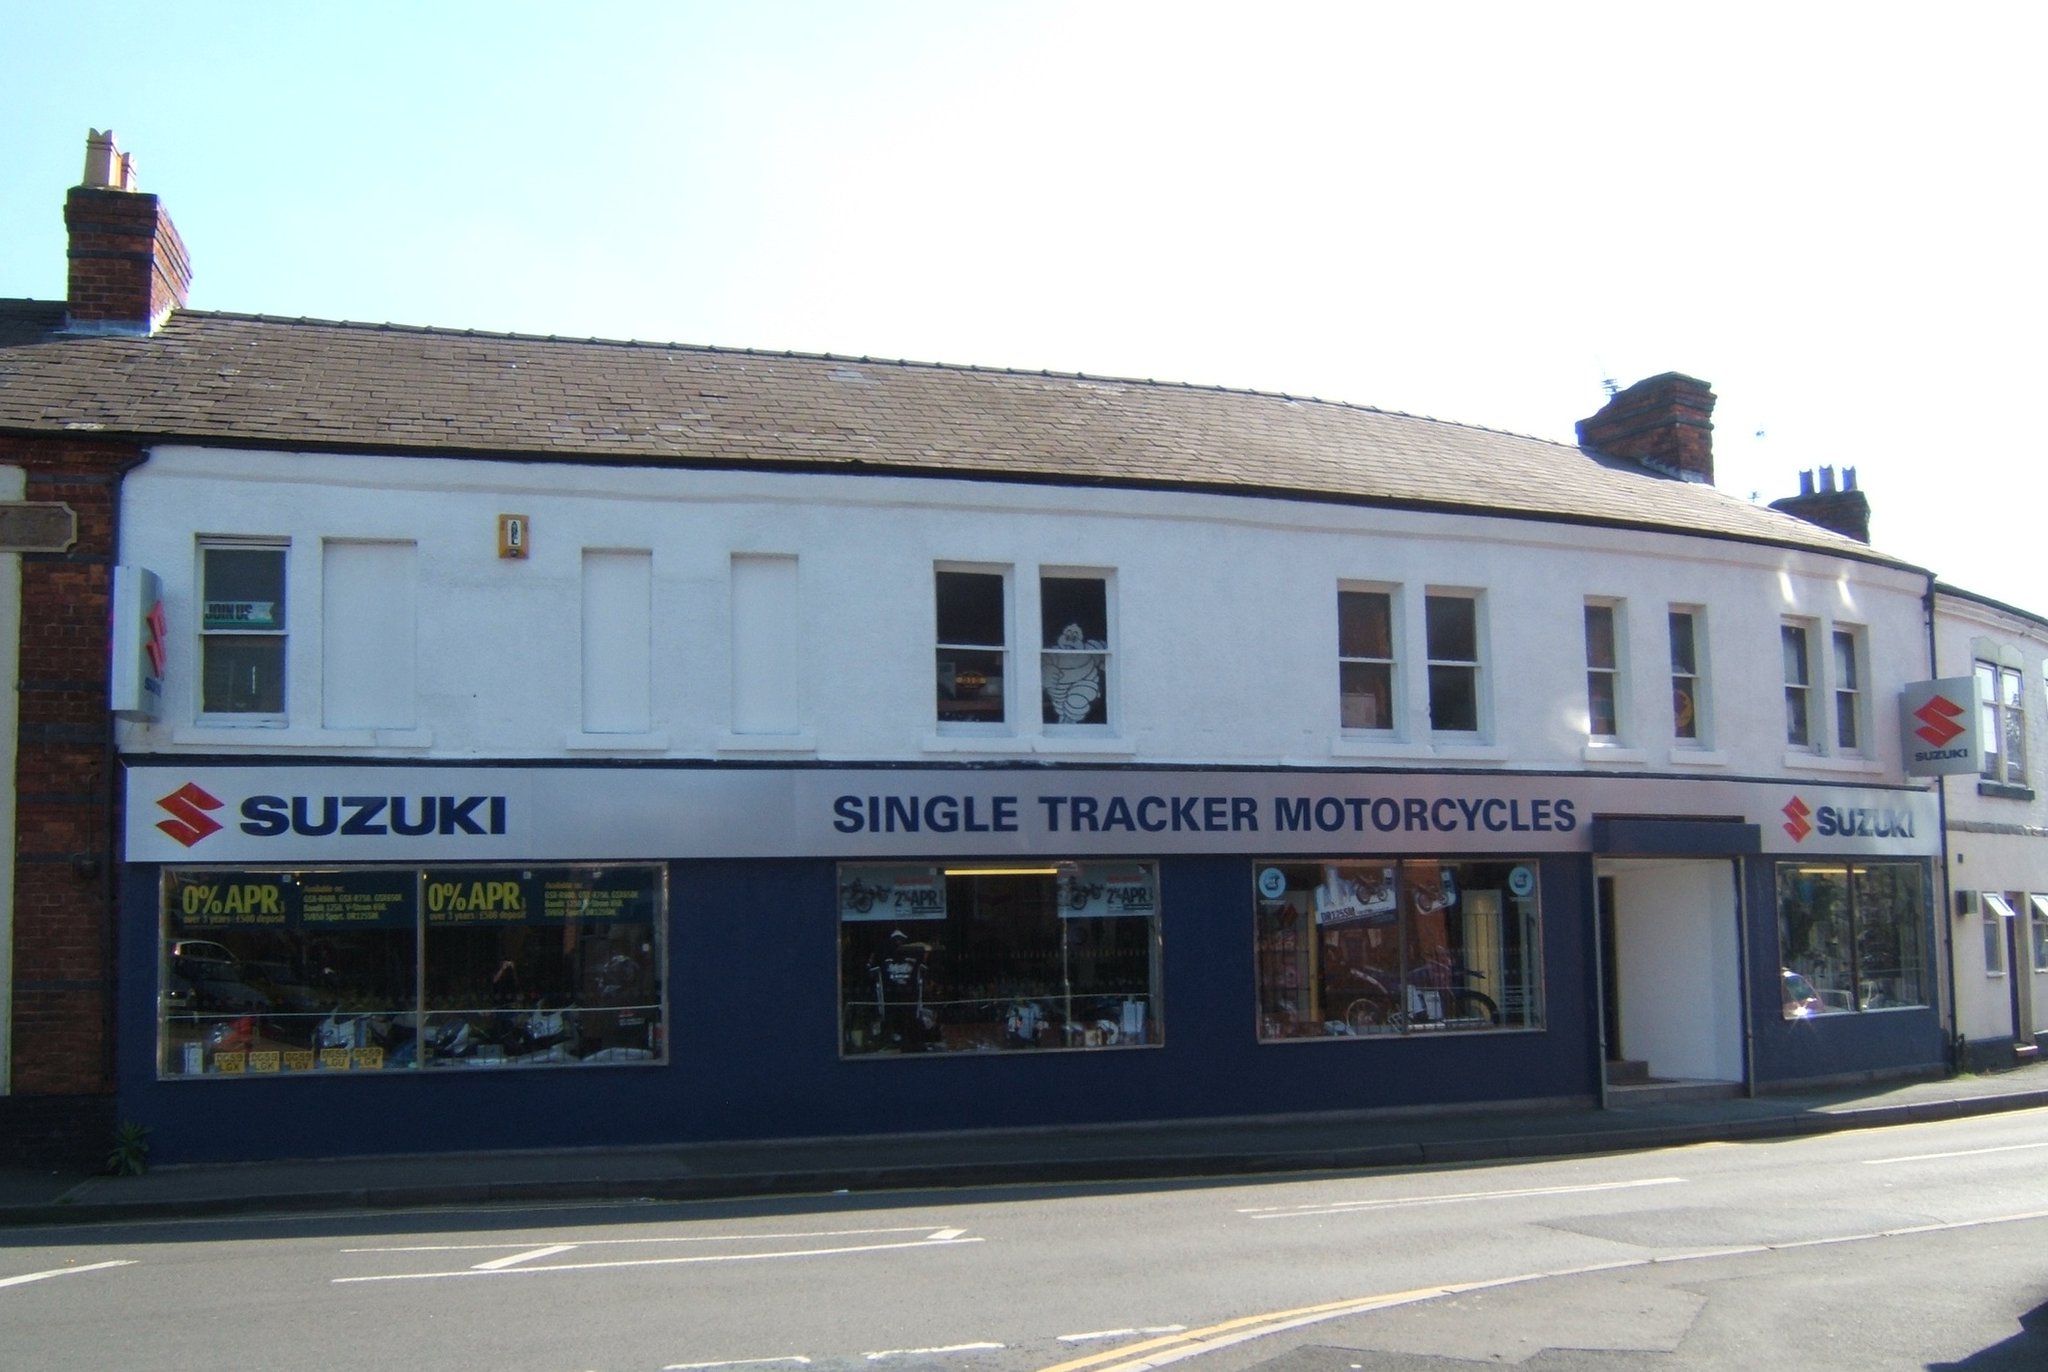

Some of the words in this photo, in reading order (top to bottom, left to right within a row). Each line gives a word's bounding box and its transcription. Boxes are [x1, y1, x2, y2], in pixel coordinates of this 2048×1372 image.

[205, 604, 234, 620] JOIN
[1915, 748, 1968, 762] SUZUKI
[240, 796, 506, 836] SUZUKI
[833, 795, 1019, 834] SINGLE
[1038, 796, 1259, 834] TRACKER
[1275, 797, 1577, 833] MOTORCYCLES
[1816, 805, 1915, 839] SUZUKI
[182, 884, 223, 914] 0%
[224, 884, 279, 914] APR
[428, 883, 466, 912] 0%
[467, 881, 521, 911] APR
